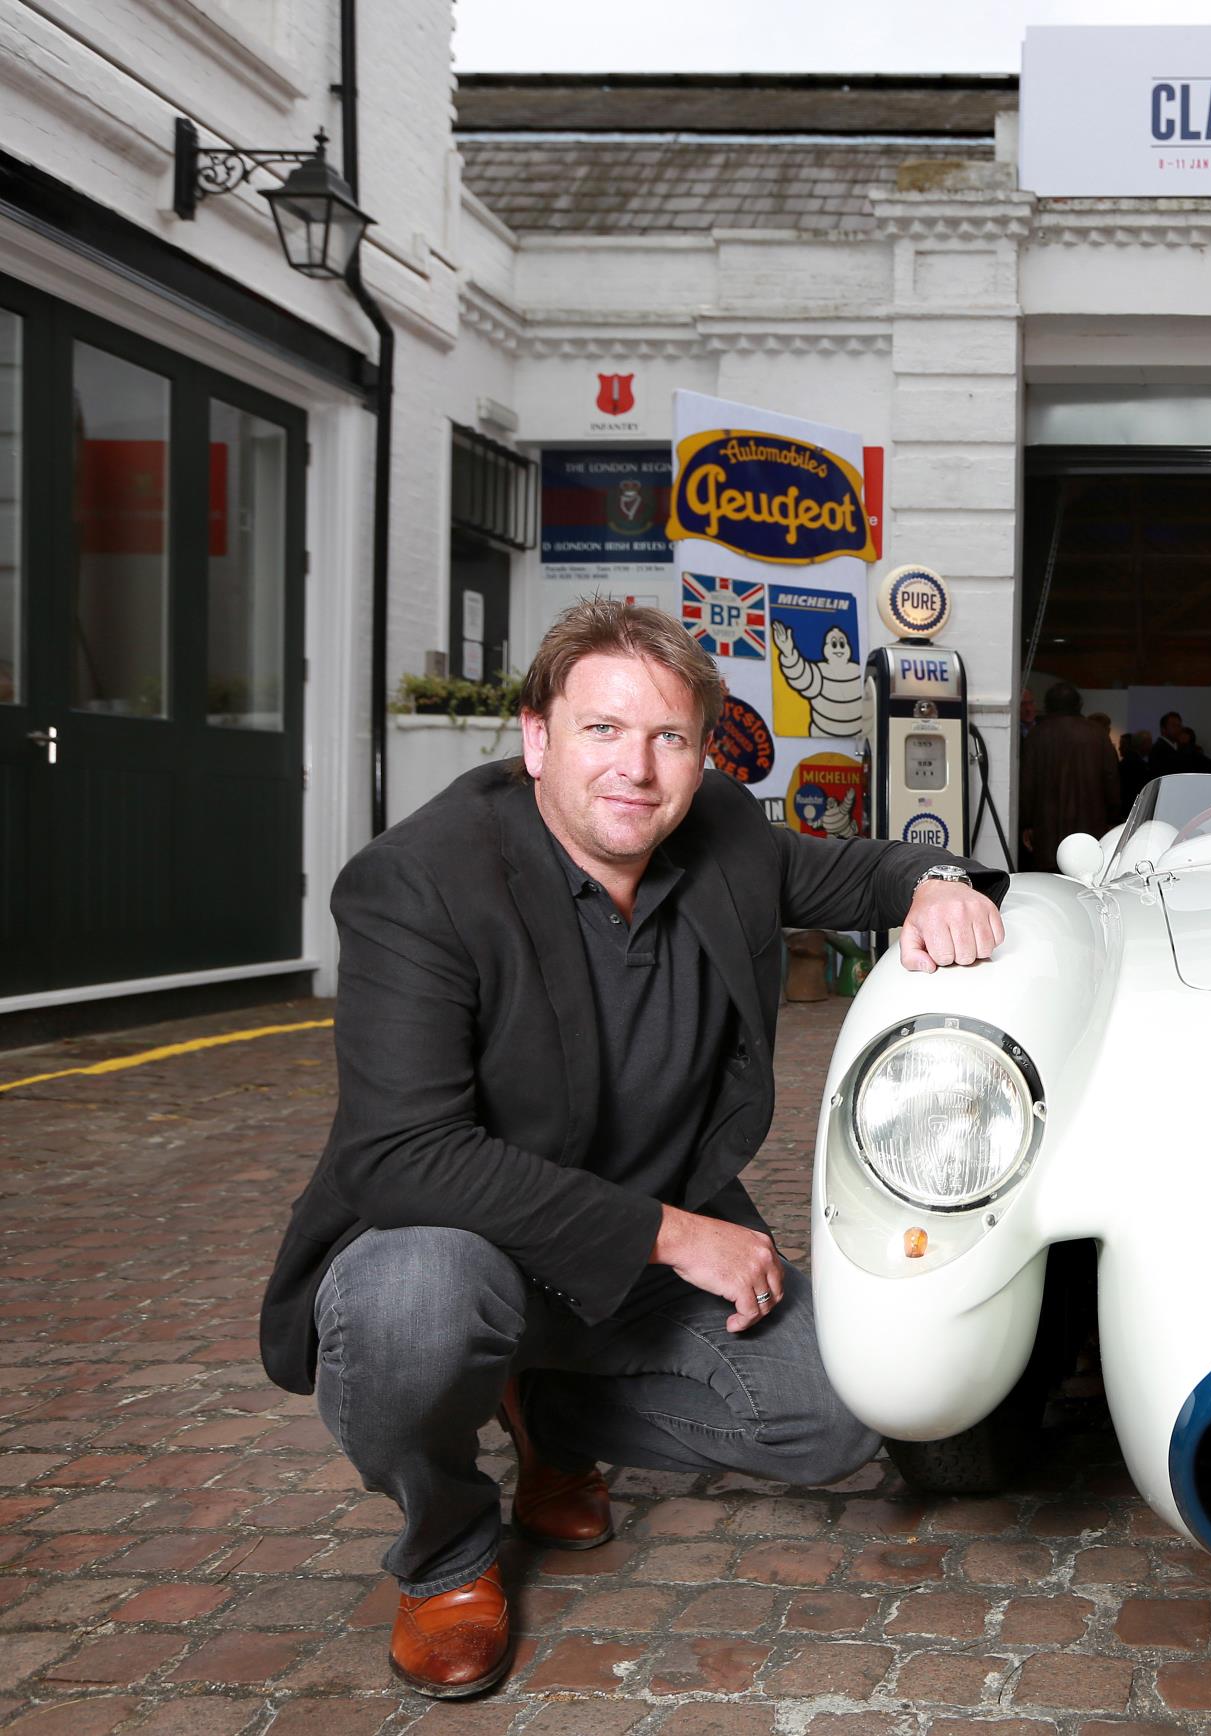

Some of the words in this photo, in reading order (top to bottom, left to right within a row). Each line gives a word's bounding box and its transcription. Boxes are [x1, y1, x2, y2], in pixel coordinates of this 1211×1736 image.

[1190, 158, 1209, 169] JAN
[589, 422, 640, 432] INFANTRY
[565, 462, 585, 473] THE
[588, 462, 638, 473] LONDON
[719, 439, 828, 479] Automobiles
[686, 464, 857, 545] Peugeot
[777, 593, 849, 611] MICHELIN
[901, 591, 937, 611] PURE
[710, 603, 741, 627] BP
[901, 659, 949, 682] PURE
[802, 770, 860, 785] MICHELIN
[910, 829, 942, 845] PURE
